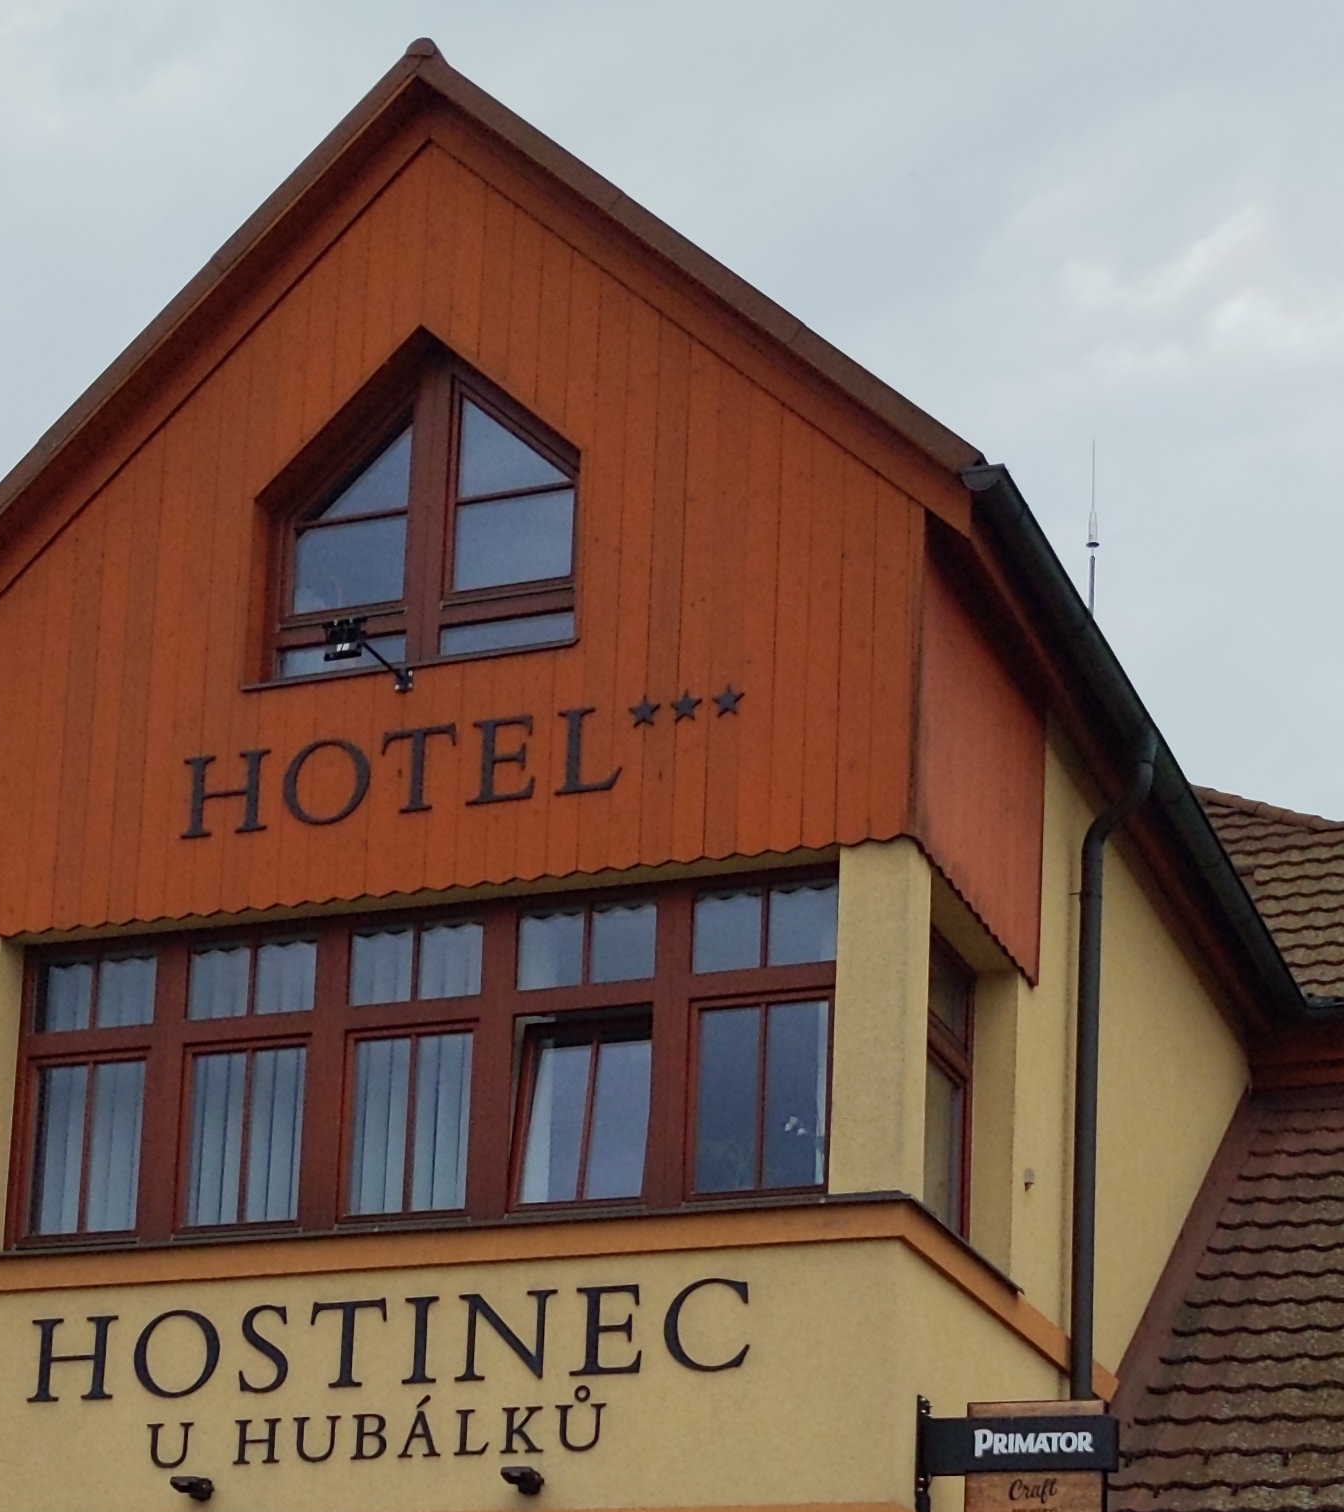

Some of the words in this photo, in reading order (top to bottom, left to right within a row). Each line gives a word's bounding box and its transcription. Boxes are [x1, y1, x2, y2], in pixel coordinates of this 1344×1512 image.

[180, 706, 623, 840] HOTEL
[26, 1277, 751, 1403] HOSTINEC
[147, 1421, 194, 1469] U
[232, 1385, 607, 1466] HUBÁLKŮ
[973, 1428, 1096, 1459] PRIMATOR
[1008, 1478, 1059, 1504] Craft
